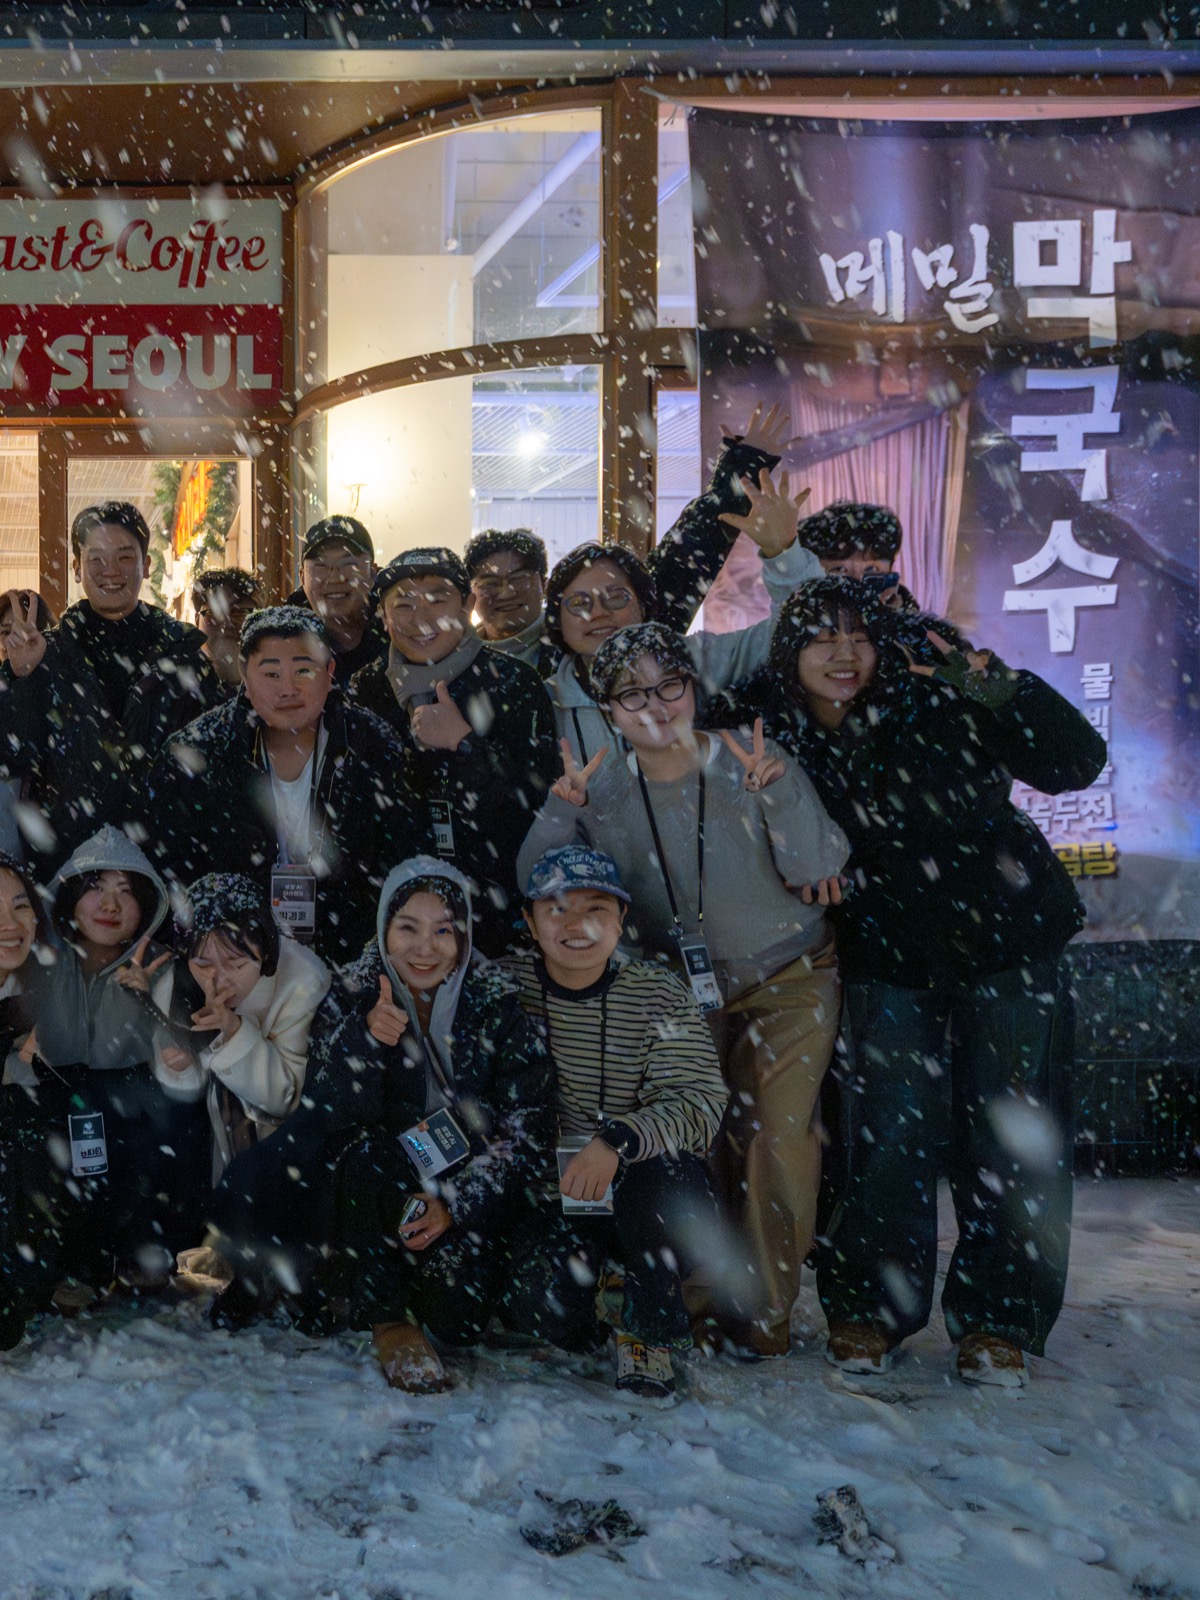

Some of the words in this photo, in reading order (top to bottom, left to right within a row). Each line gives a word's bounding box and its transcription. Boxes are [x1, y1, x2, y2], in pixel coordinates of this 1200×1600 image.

[819, 223, 999, 334] 메밀
[50, 334, 272, 391] SEOUL
[1002, 209, 1133, 653] 막국수
